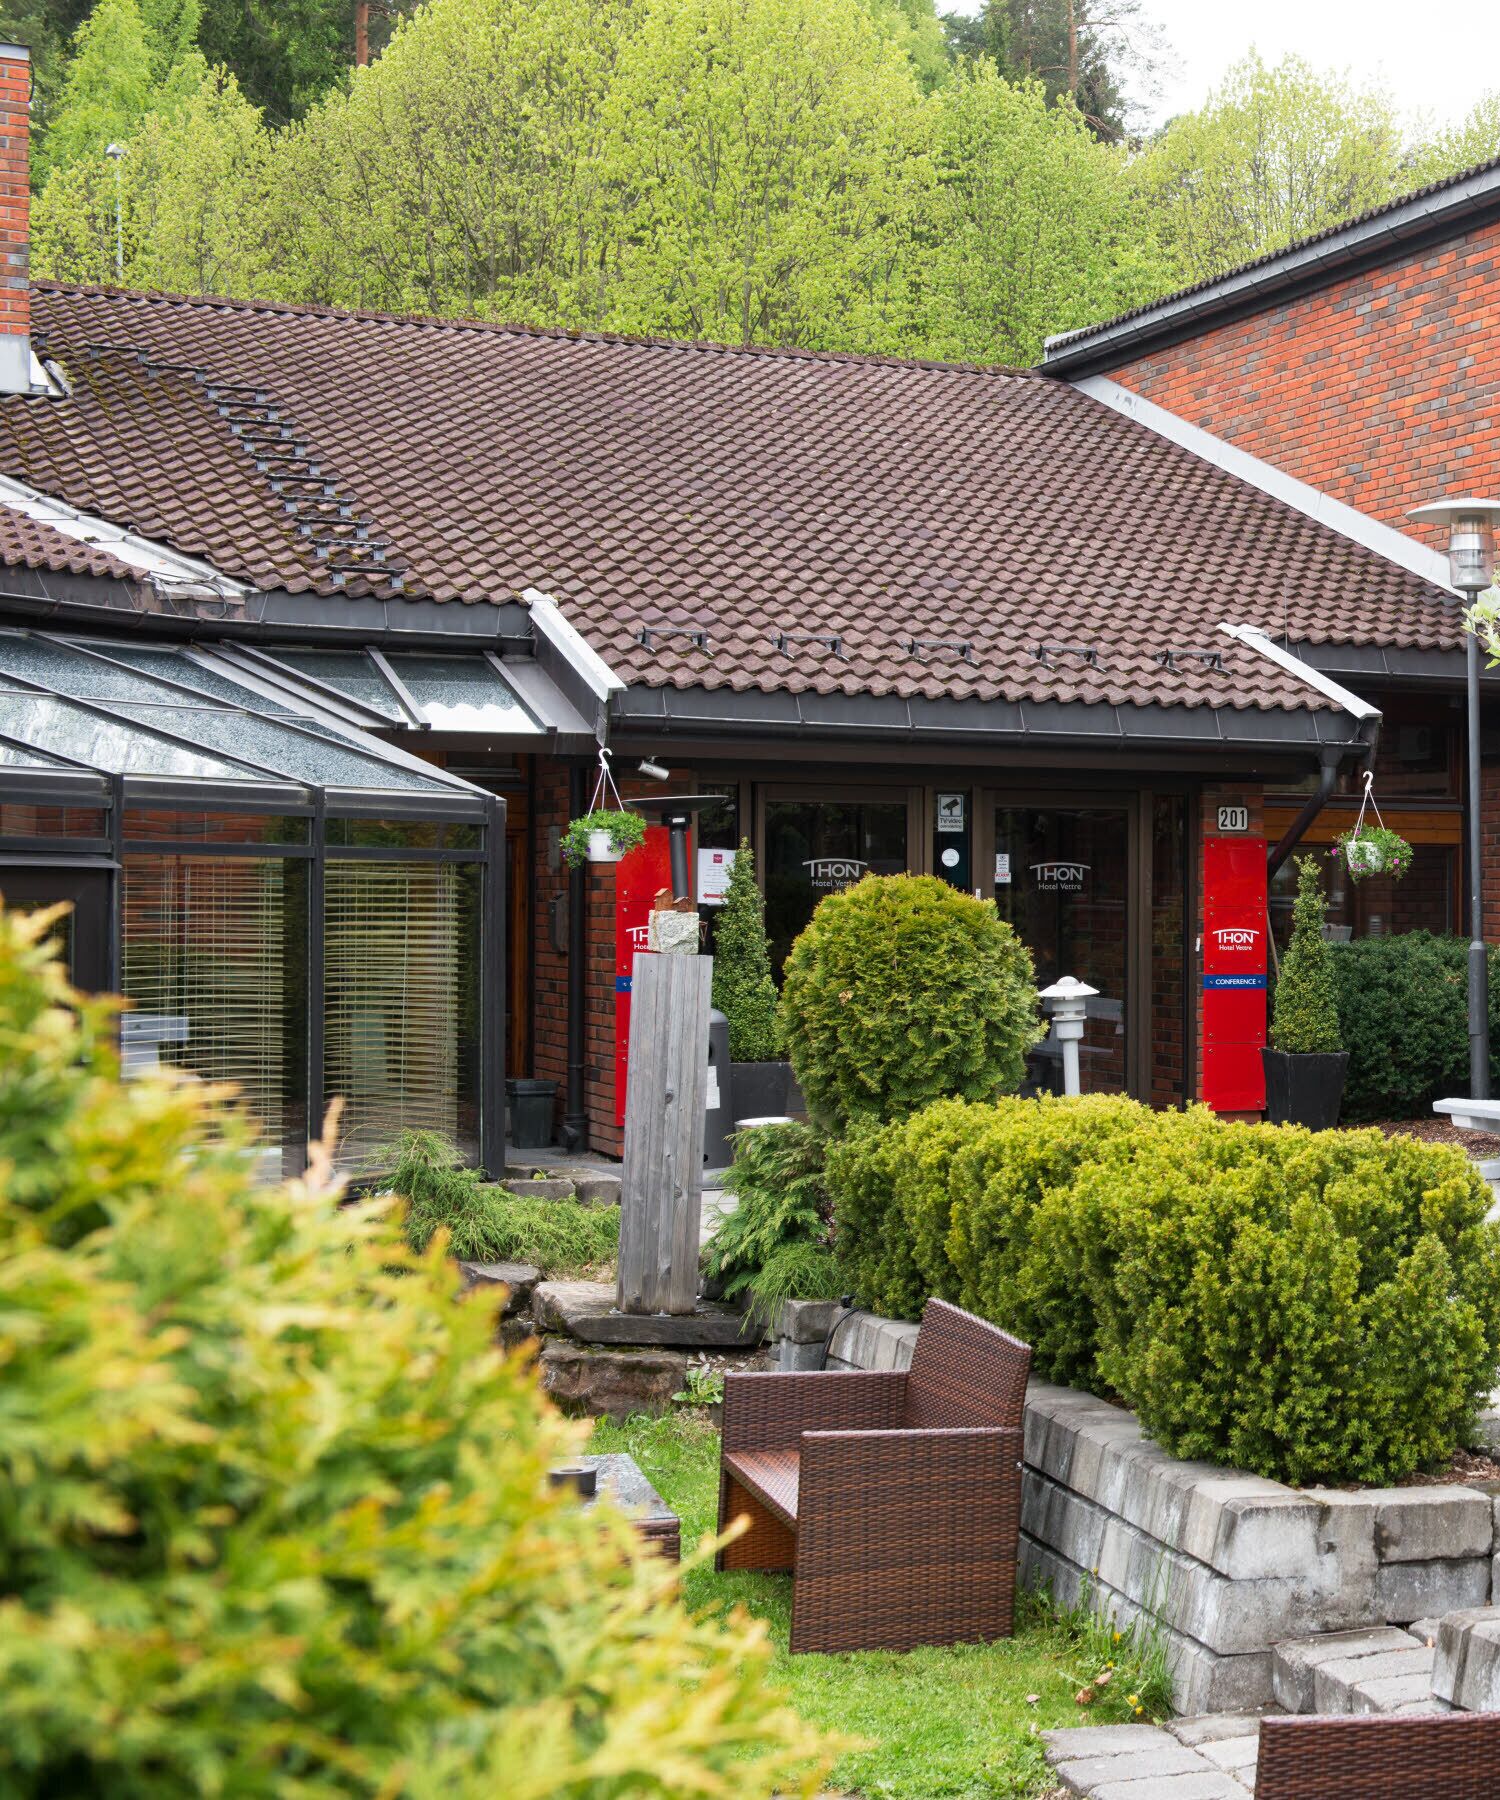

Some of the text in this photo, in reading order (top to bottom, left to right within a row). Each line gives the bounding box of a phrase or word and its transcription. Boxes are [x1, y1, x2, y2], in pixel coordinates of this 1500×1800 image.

[1220, 809, 1245, 827] 201
[802, 858, 868, 877] THON
[1029, 862, 1091, 880] THON
[626, 926, 649, 941] TH
[1212, 928, 1260, 943] THON
